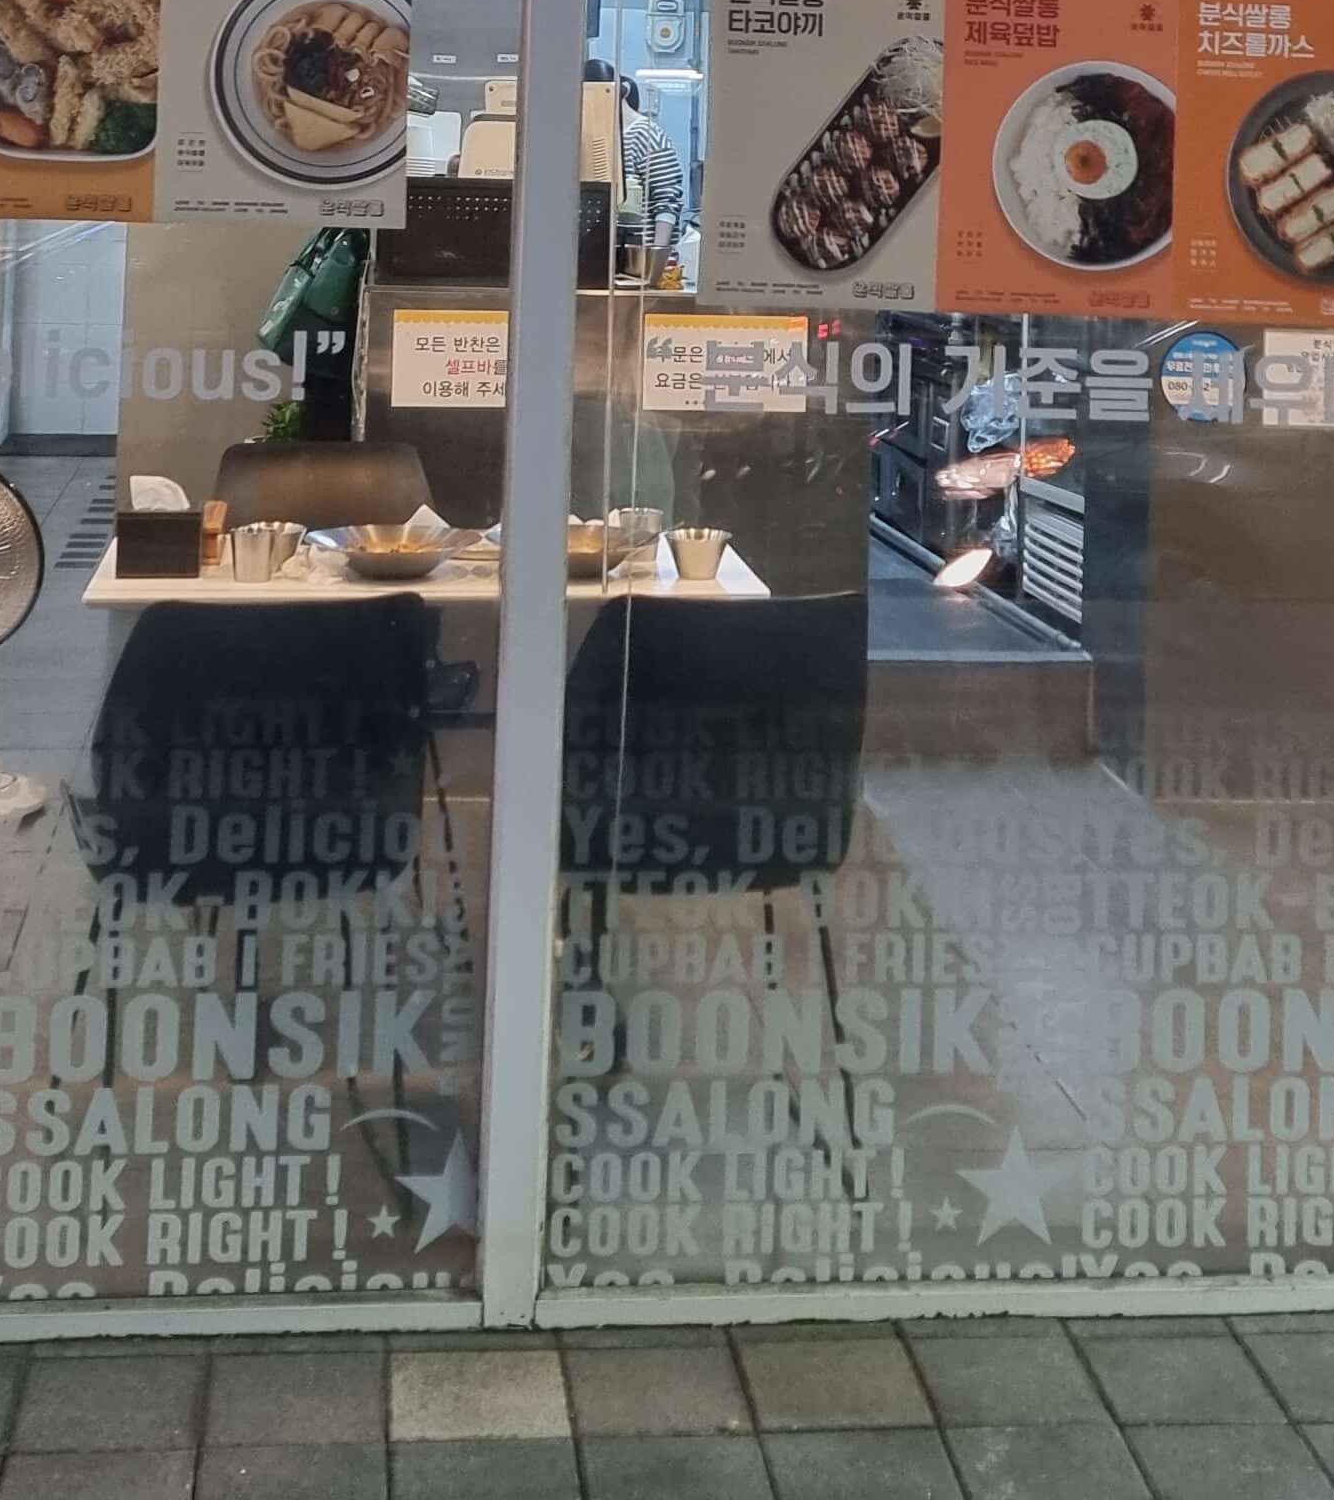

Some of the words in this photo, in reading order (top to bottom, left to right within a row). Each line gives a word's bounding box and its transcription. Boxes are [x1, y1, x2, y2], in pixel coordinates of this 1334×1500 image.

[728, 9, 824, 37] 타코야끼
[1198, 2, 1292, 30] 분식쌀롱
[964, 20, 1060, 48] 제육덮밥
[1197, 30, 1316, 59] 치즈롤까스
[415, 336, 447, 353] 모든
[454, 336, 501, 353] 반찬은
[445, 359, 508, 376] 셀프바를
[654, 372, 704, 390] 요금은
[423, 381, 469, 398] 이용해
[559, 987, 993, 1078] BOONSIK
[556, 1078, 897, 1151] SSALONG
[552, 1150, 703, 1202] COOK
[1082, 1144, 1228, 1198] COOK
[549, 1202, 702, 1258] COOK
[1080, 1197, 1228, 1249] COOK
